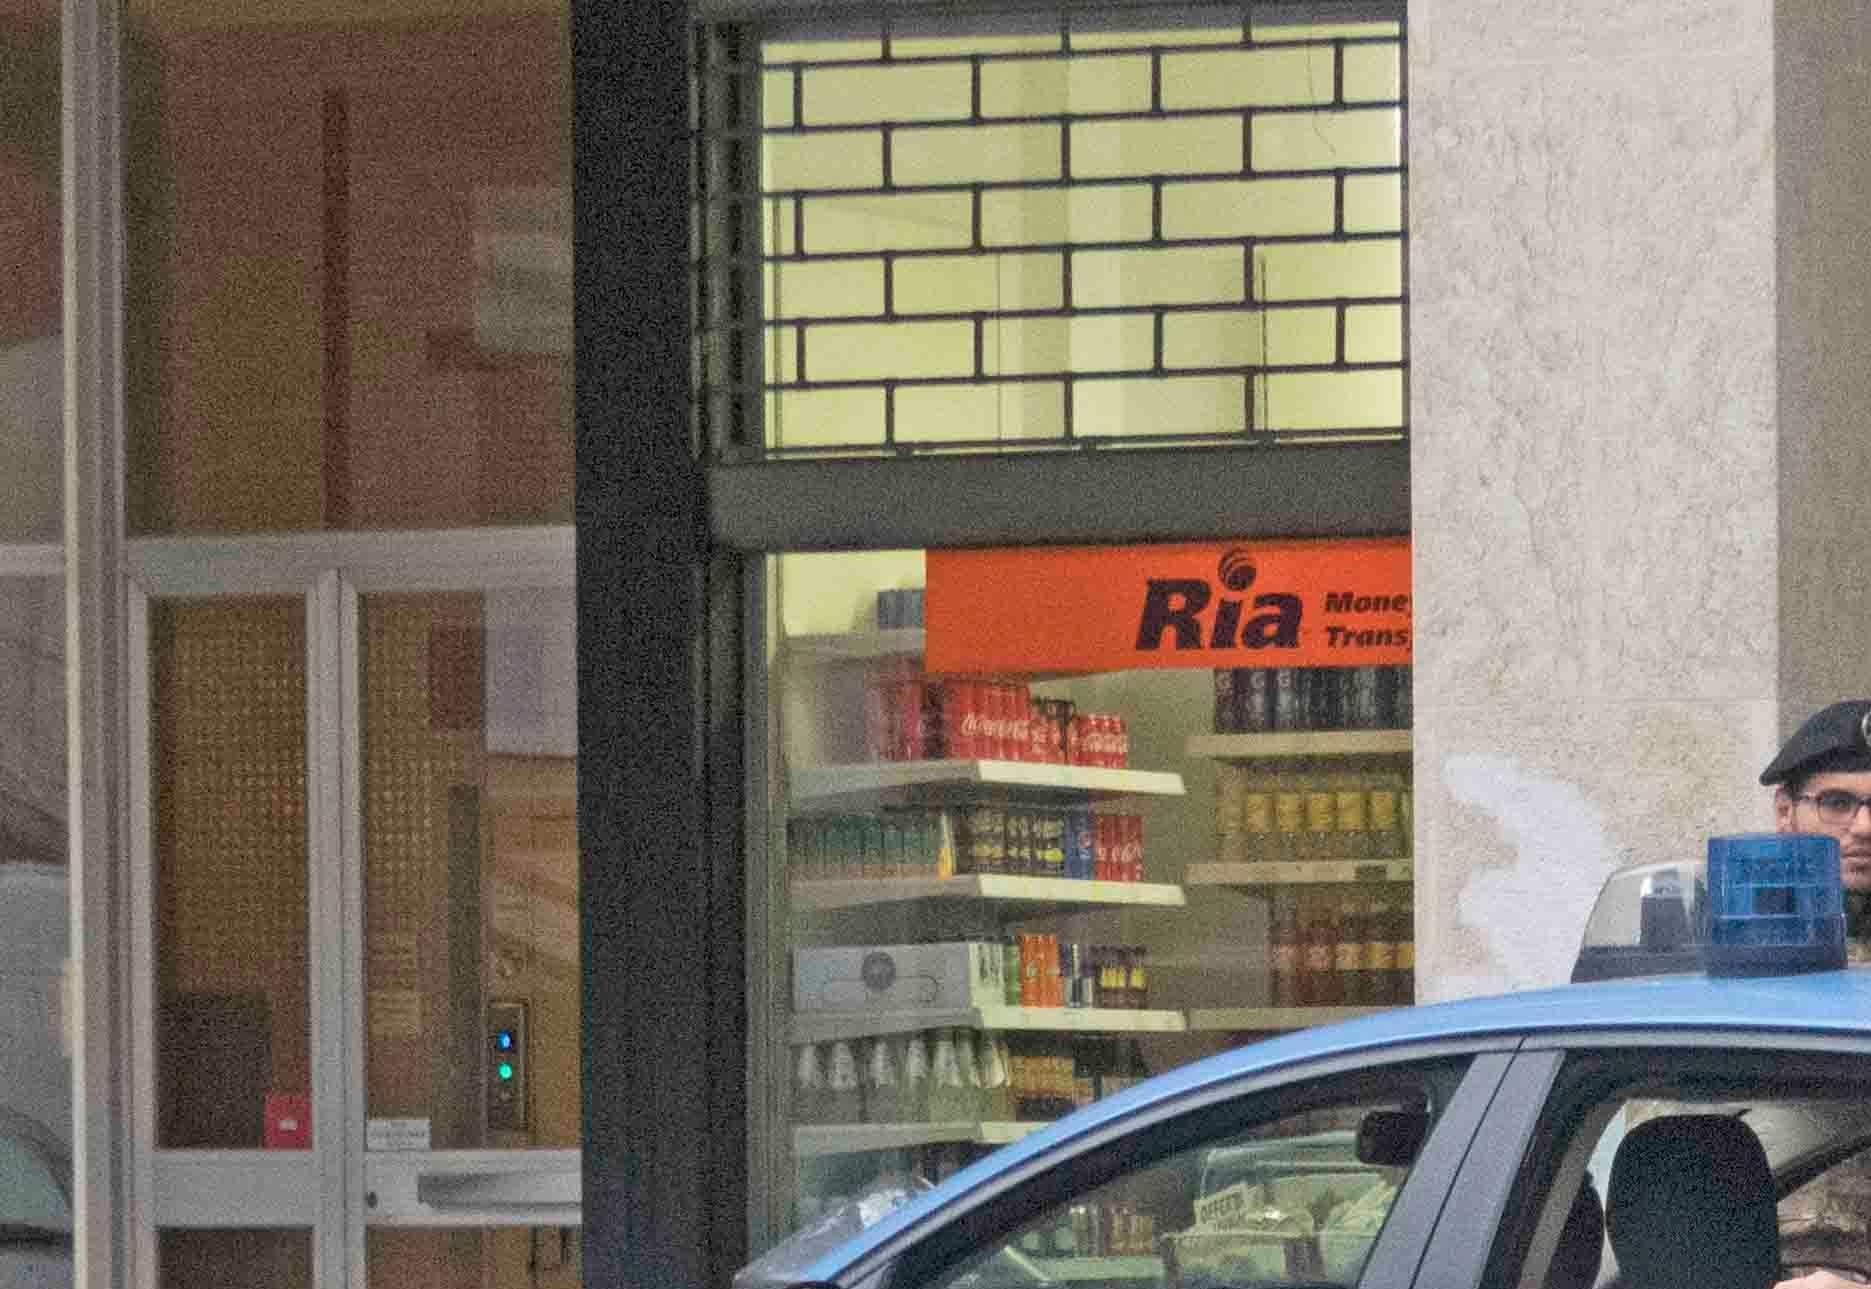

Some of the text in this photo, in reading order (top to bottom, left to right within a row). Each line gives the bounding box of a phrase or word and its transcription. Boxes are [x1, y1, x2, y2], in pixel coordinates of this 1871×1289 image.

[1136, 549, 1303, 651] Ria
[1324, 592, 1412, 620] Mone
[1325, 625, 1412, 653] Trans
